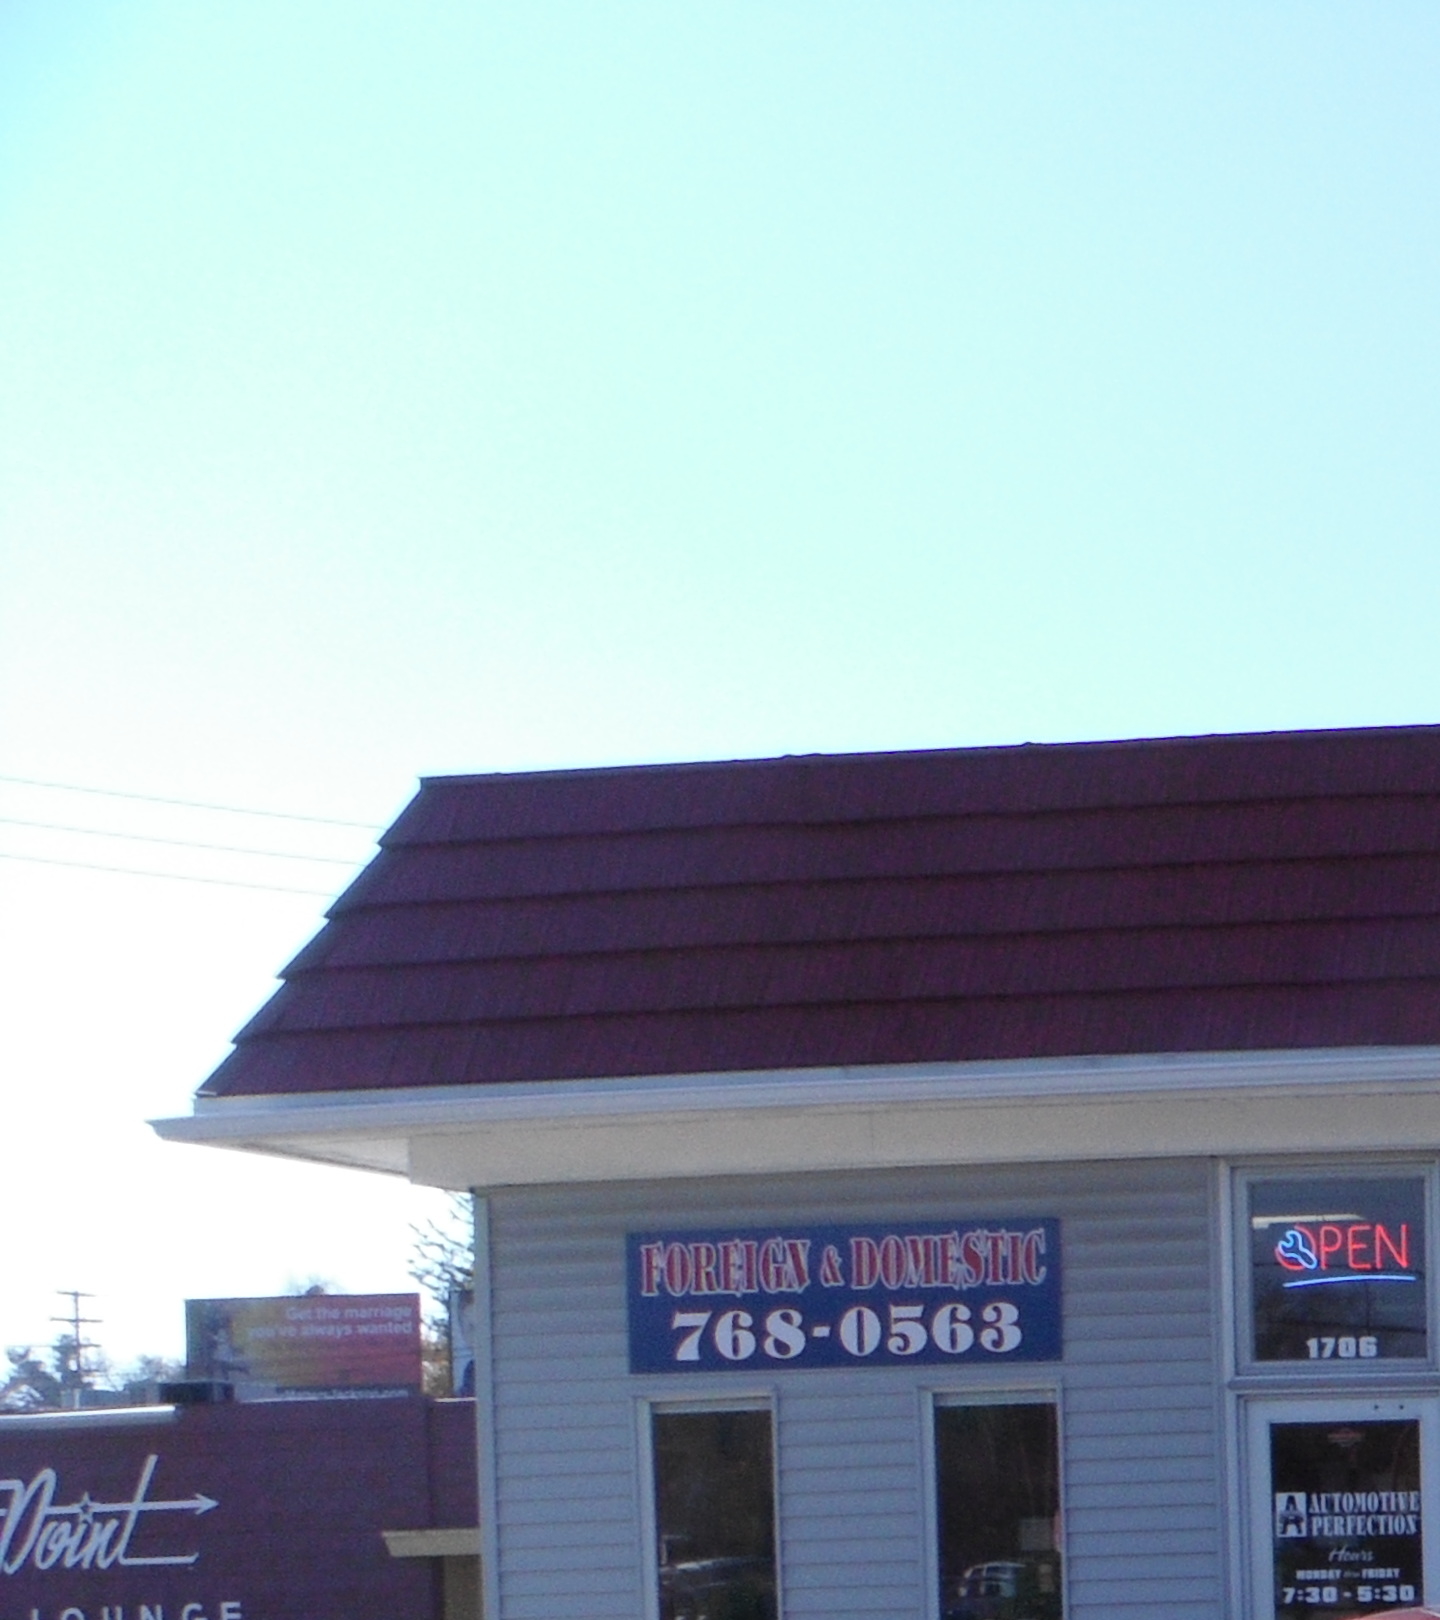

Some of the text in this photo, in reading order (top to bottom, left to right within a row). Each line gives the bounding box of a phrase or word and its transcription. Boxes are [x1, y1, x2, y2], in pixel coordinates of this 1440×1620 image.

[1274, 1224, 1409, 1271] OPEN
[640, 1227, 1047, 1298] FOREIGN & DOMESTIC
[286, 1305, 411, 1320] Get the marriage
[301, 1321, 352, 1339] always
[357, 1321, 412, 1335] wanted
[671, 1302, 1023, 1361] 768-0563
[1306, 1336, 1378, 1358] 1706
[1309, 1491, 1420, 1514] AUTOMOTIVE
[1311, 1514, 1418, 1536] PERFECTION
[1328, 1546, 1374, 1562] Hours
[1296, 1569, 1342, 1580] MONDAY
[1362, 1568, 1400, 1579] FRIDAY
[1282, 1586, 1338, 1604] 7:30
[1357, 1585, 1415, 1603] 5:30
